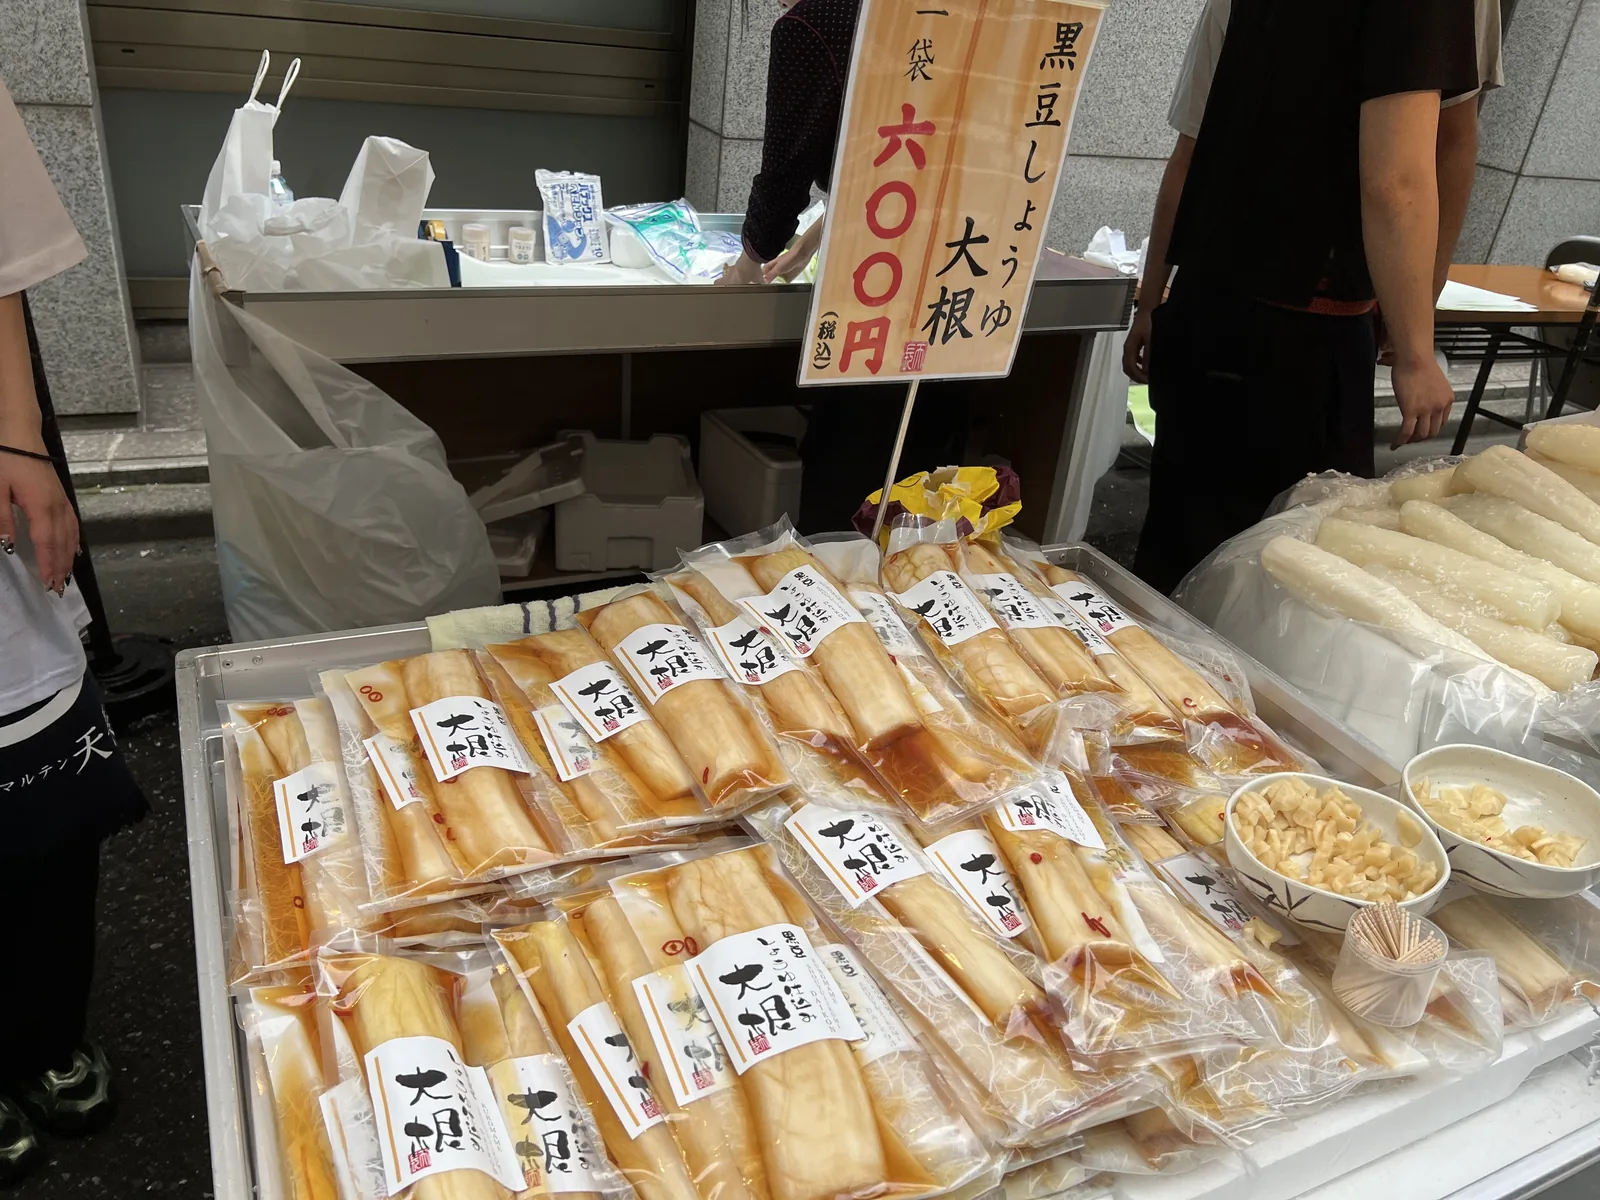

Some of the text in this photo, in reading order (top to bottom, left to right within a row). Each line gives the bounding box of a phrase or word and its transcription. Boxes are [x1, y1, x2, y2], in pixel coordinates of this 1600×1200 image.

[903, 9, 949, 82] 一袋
[980, 21, 1084, 338] 黒豆しょうゆ
[921, 216, 990, 346] 大根
[764, 603, 821, 647] 大根
[1069, 591, 1125, 631] 大根
[636, 640, 692, 684] 大根
[729, 629, 779, 677] 大根
[578, 679, 638, 720] 大根
[436, 714, 492, 761] 大根
[818, 819, 895, 883] 大根
[1185, 872, 1251, 923] 大根
[781, 930, 807, 959] 黒豆
[718, 963, 796, 1041] 大根
[395, 1066, 466, 1159] 大根
[507, 1086, 573, 1178] 大根
